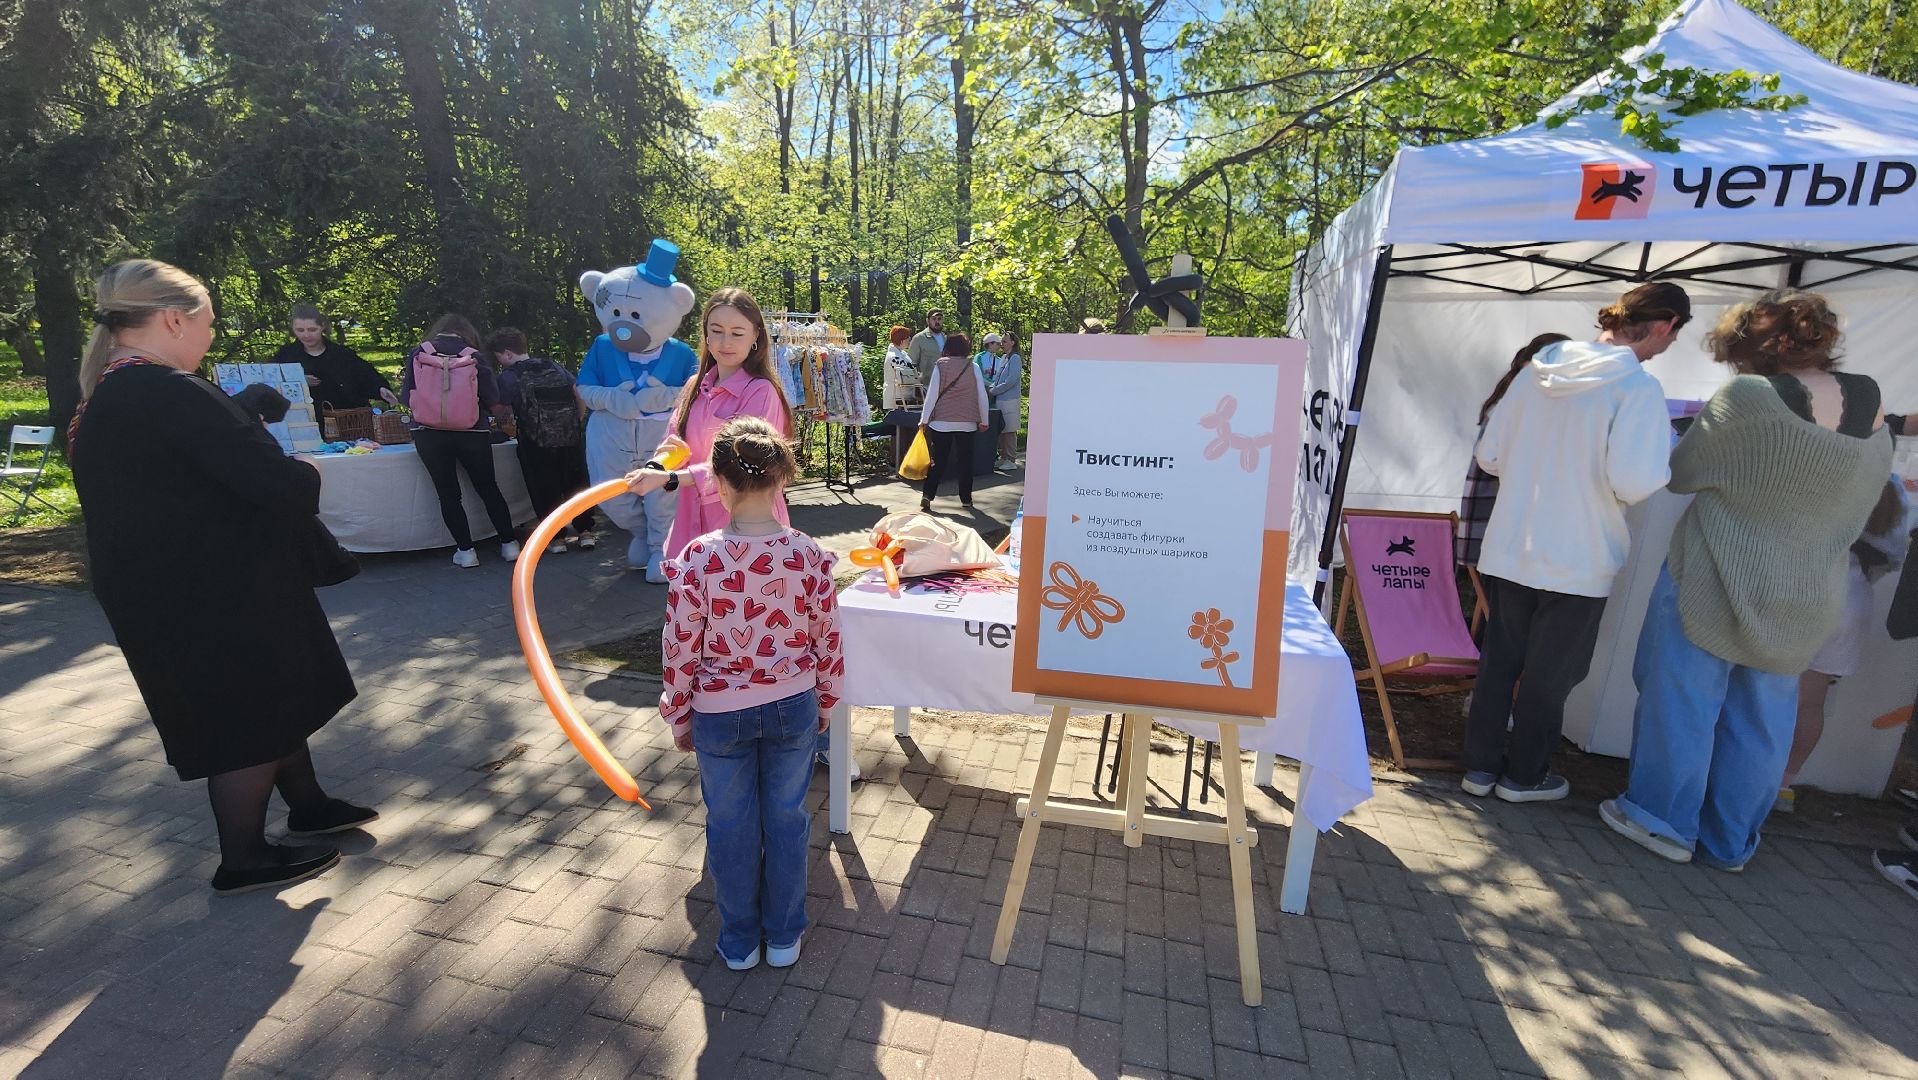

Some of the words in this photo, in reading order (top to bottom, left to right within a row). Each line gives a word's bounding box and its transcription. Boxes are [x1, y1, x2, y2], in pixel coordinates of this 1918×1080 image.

[1075, 449, 1174, 469] Твистинг:
[1073, 486, 1102, 496] Здесь
[1105, 488, 1119, 497] Вы
[1121, 490, 1163, 500] можете:
[1088, 515, 1142, 527] Научиться
[1086, 530, 1138, 541] создавать
[1140, 532, 1185, 544] фигурки
[1086, 544, 1098, 552] из
[1100, 545, 1158, 556] воздушных
[1161, 549, 1208, 559] шариков
[1372, 564, 1431, 577] четыре
[1382, 577, 1425, 589] лапы
[965, 620, 1016, 649] че
